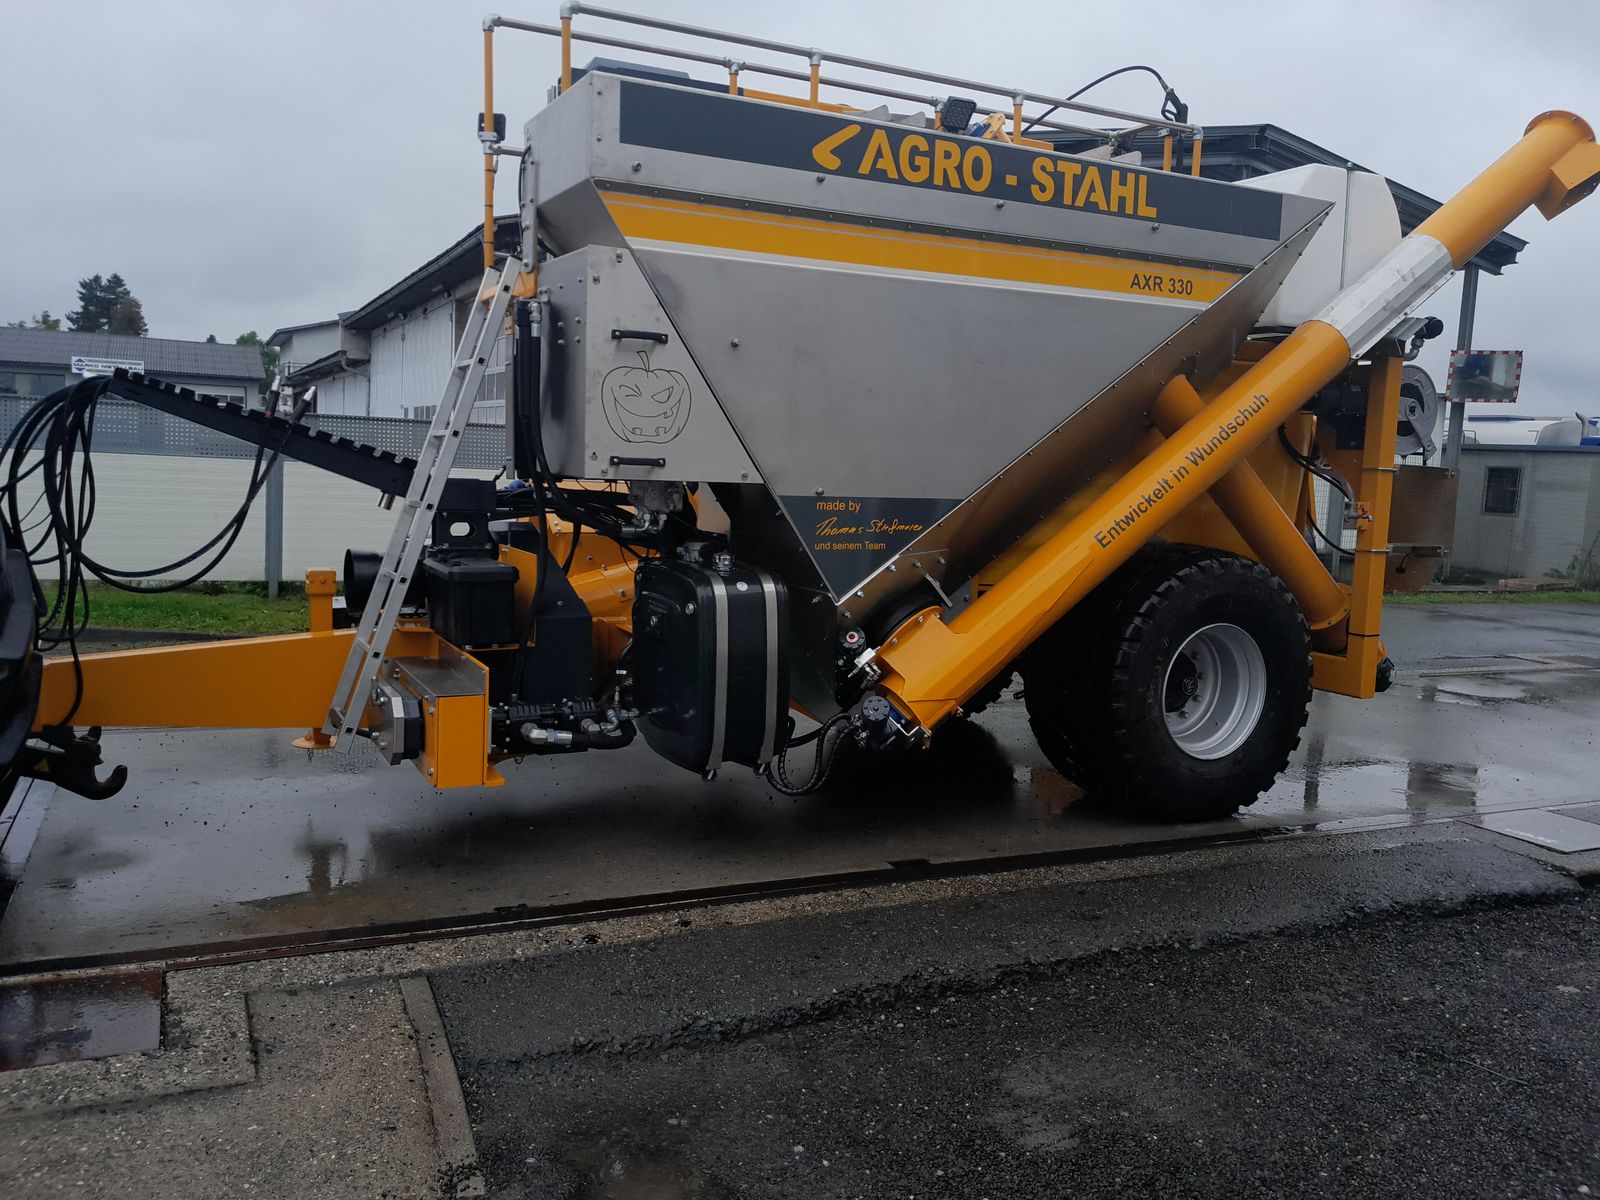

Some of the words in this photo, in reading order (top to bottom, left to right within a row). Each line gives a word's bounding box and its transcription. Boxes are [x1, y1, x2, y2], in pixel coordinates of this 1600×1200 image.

[857, 128, 993, 193] AGRO
[1030, 156, 1158, 218] STAHL
[1129, 273, 1164, 293] AXR
[1167, 277, 1194, 296] 330
[1093, 478, 1175, 550] Entwickelt
[1169, 464, 1190, 483] in
[1184, 392, 1270, 468] Wundschuh
[816, 500, 846, 511] made
[848, 500, 861, 513] by
[815, 517, 865, 537] Thomas
[814, 541, 831, 551] und
[832, 541, 862, 551] seinem
[864, 541, 886, 551] Team
